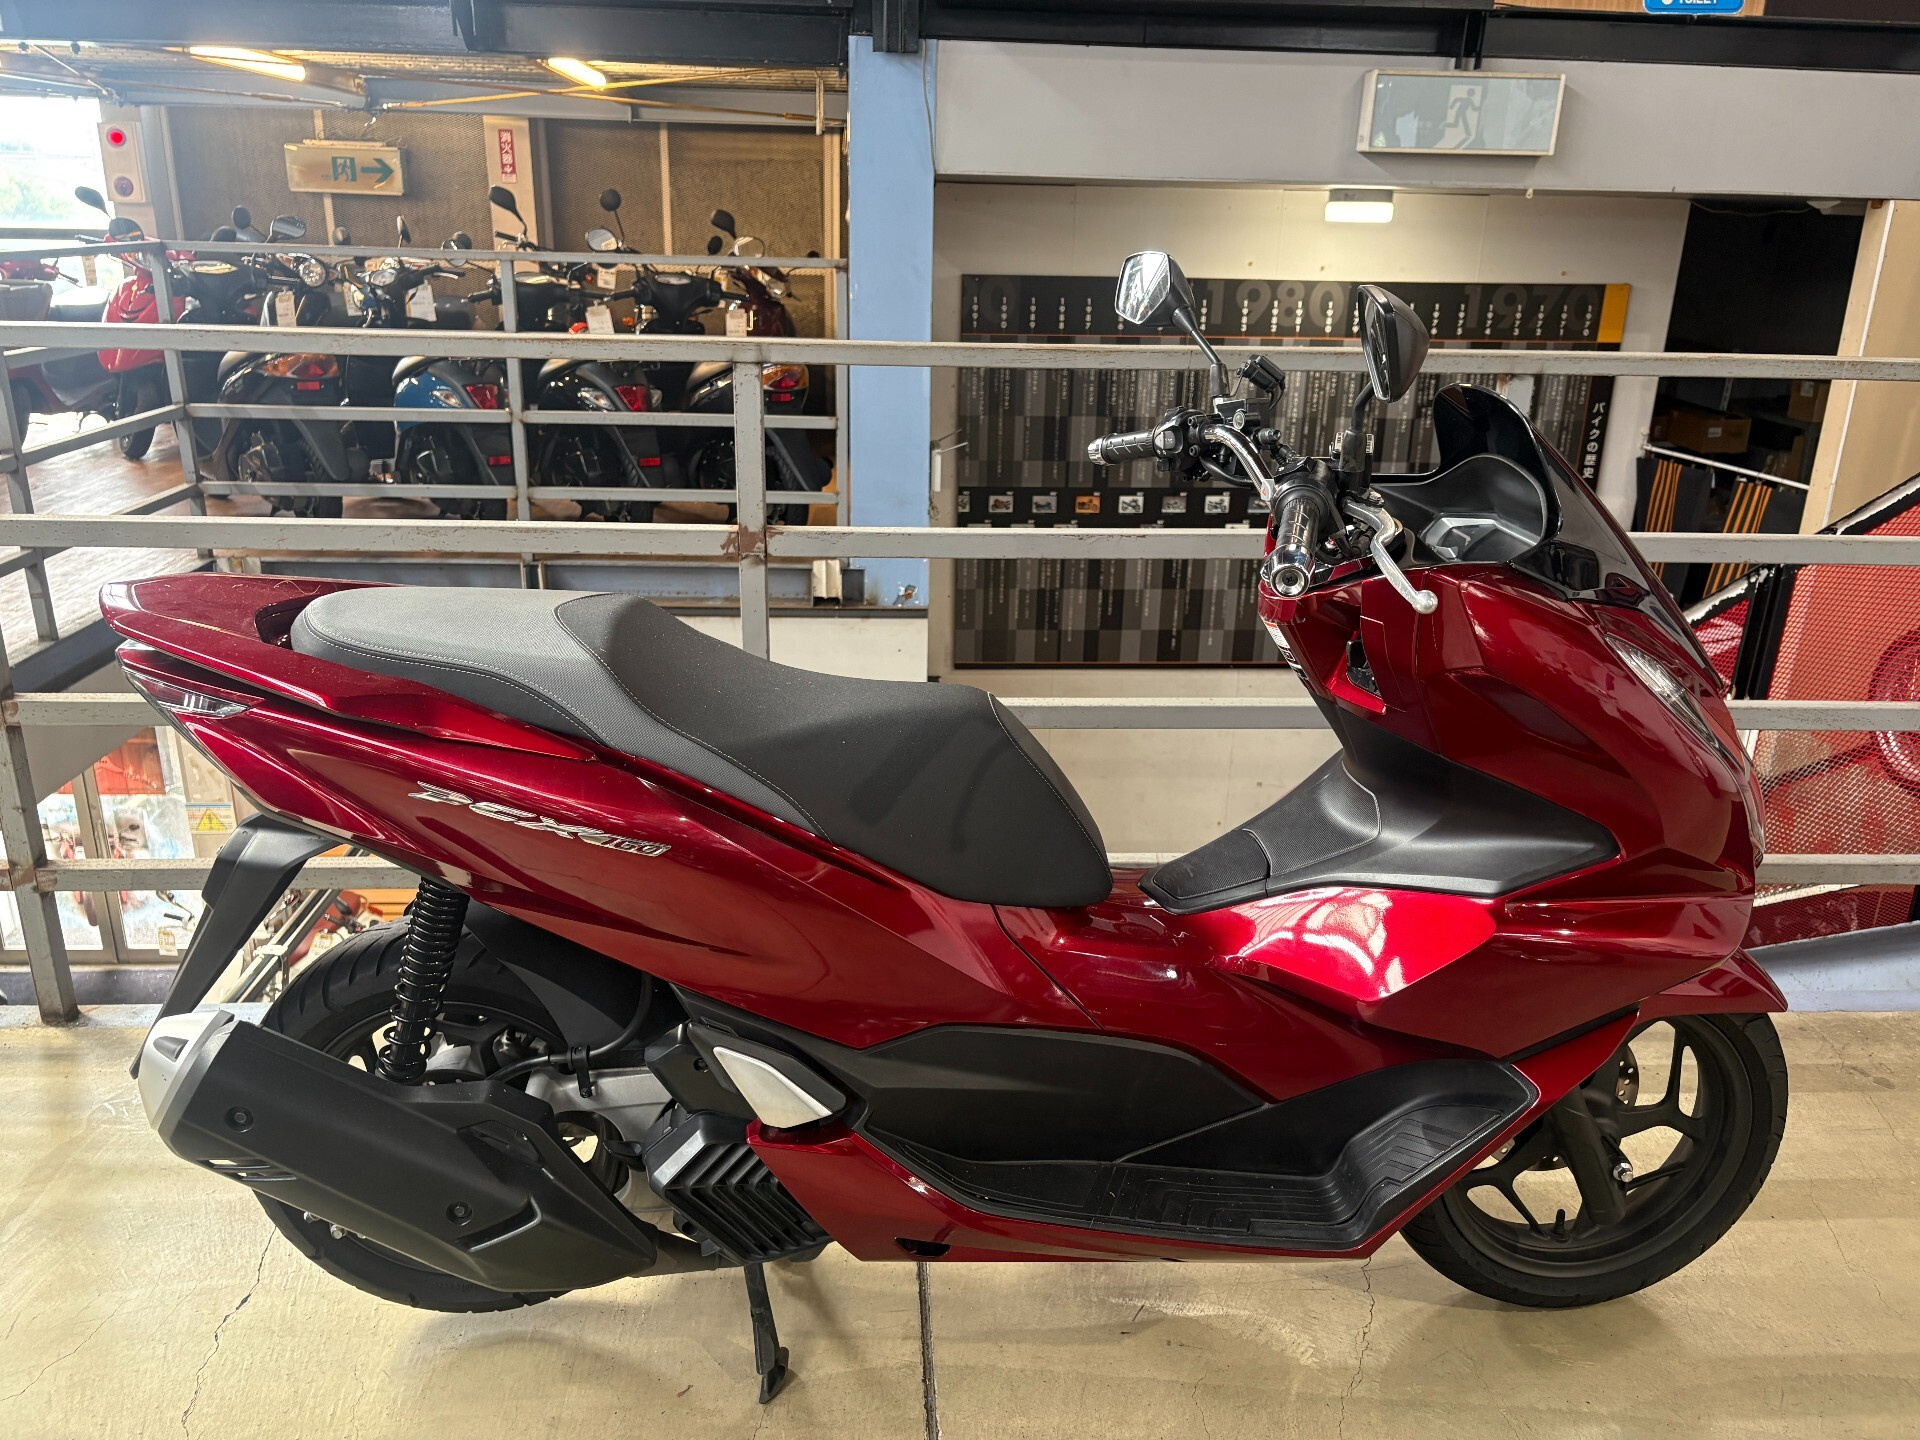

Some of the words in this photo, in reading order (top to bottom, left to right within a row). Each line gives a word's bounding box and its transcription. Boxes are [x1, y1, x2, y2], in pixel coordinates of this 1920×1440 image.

[1000, 296, 1008, 329] 1990
[1029, 297, 1037, 330] 1989
[1058, 297, 1066, 330] 1988
[1085, 297, 1093, 330] 1987
[1207, 279, 1344, 328] 1980
[1240, 299, 1249, 332] 1983
[1270, 300, 1279, 332] 1982
[1295, 300, 1303, 333] 1981
[1324, 300, 1334, 333] 1980
[1430, 303, 1440, 336] 1976
[1456, 303, 1466, 336] 1975
[1464, 283, 1598, 331] 1970
[1484, 303, 1494, 336] 1974
[1513, 304, 1522, 336] 1973
[1535, 304, 1545, 336] 1972
[1559, 304, 1568, 336] 1971
[1583, 304, 1592, 337] 1970
[1582, 402, 1606, 479] バイクの歴史
